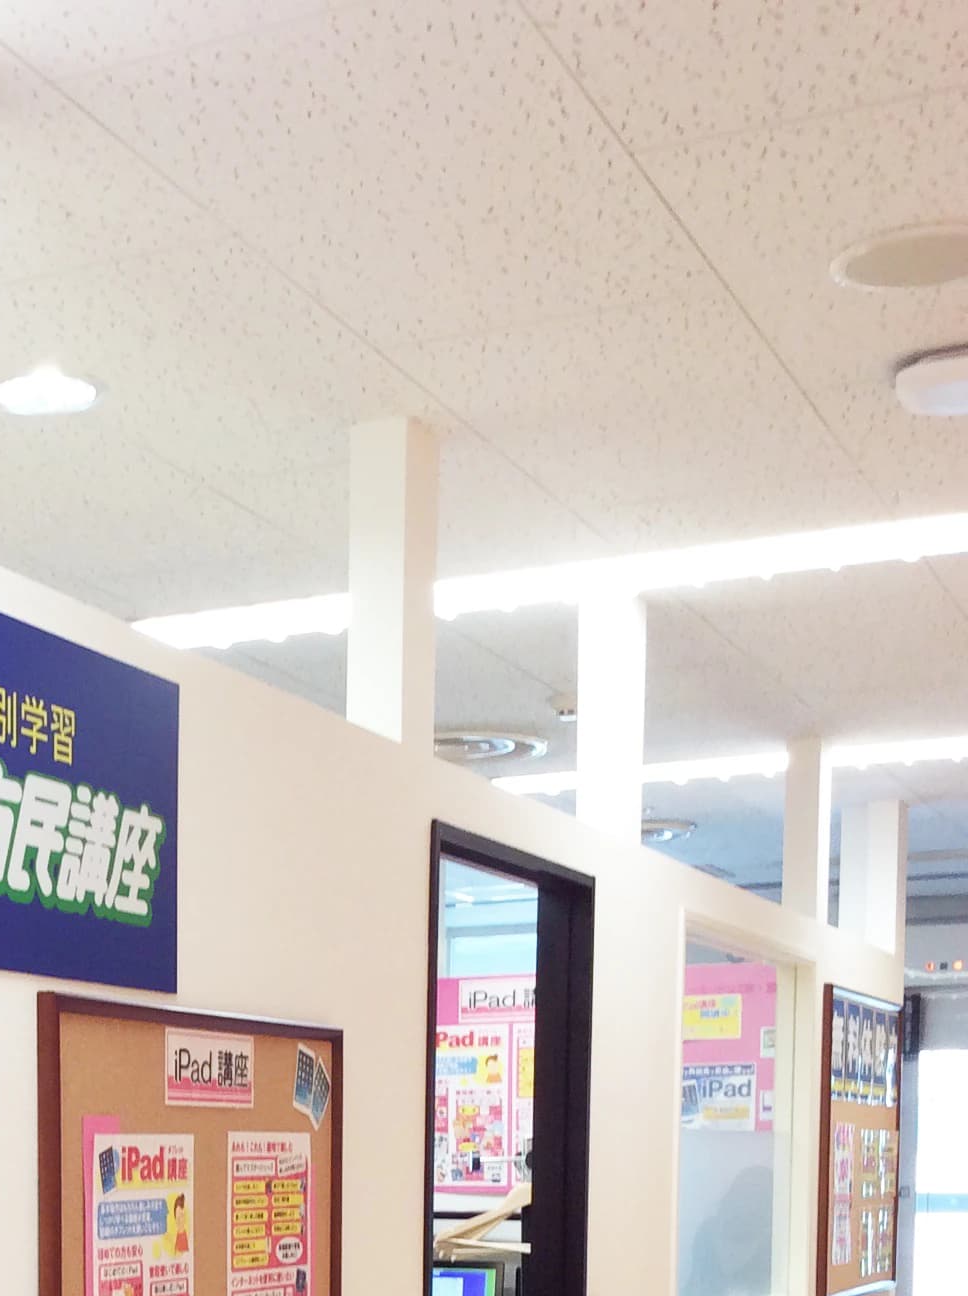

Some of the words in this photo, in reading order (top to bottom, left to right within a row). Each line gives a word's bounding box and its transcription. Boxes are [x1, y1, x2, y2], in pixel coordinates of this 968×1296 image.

[469, 989, 516, 1009] iPad
[435, 1031, 474, 1049] Pad
[174, 1048, 212, 1083] iPad
[218, 1050, 249, 1088] 講座
[701, 1079, 752, 1100] iPad
[121, 1145, 165, 1183] iPad
